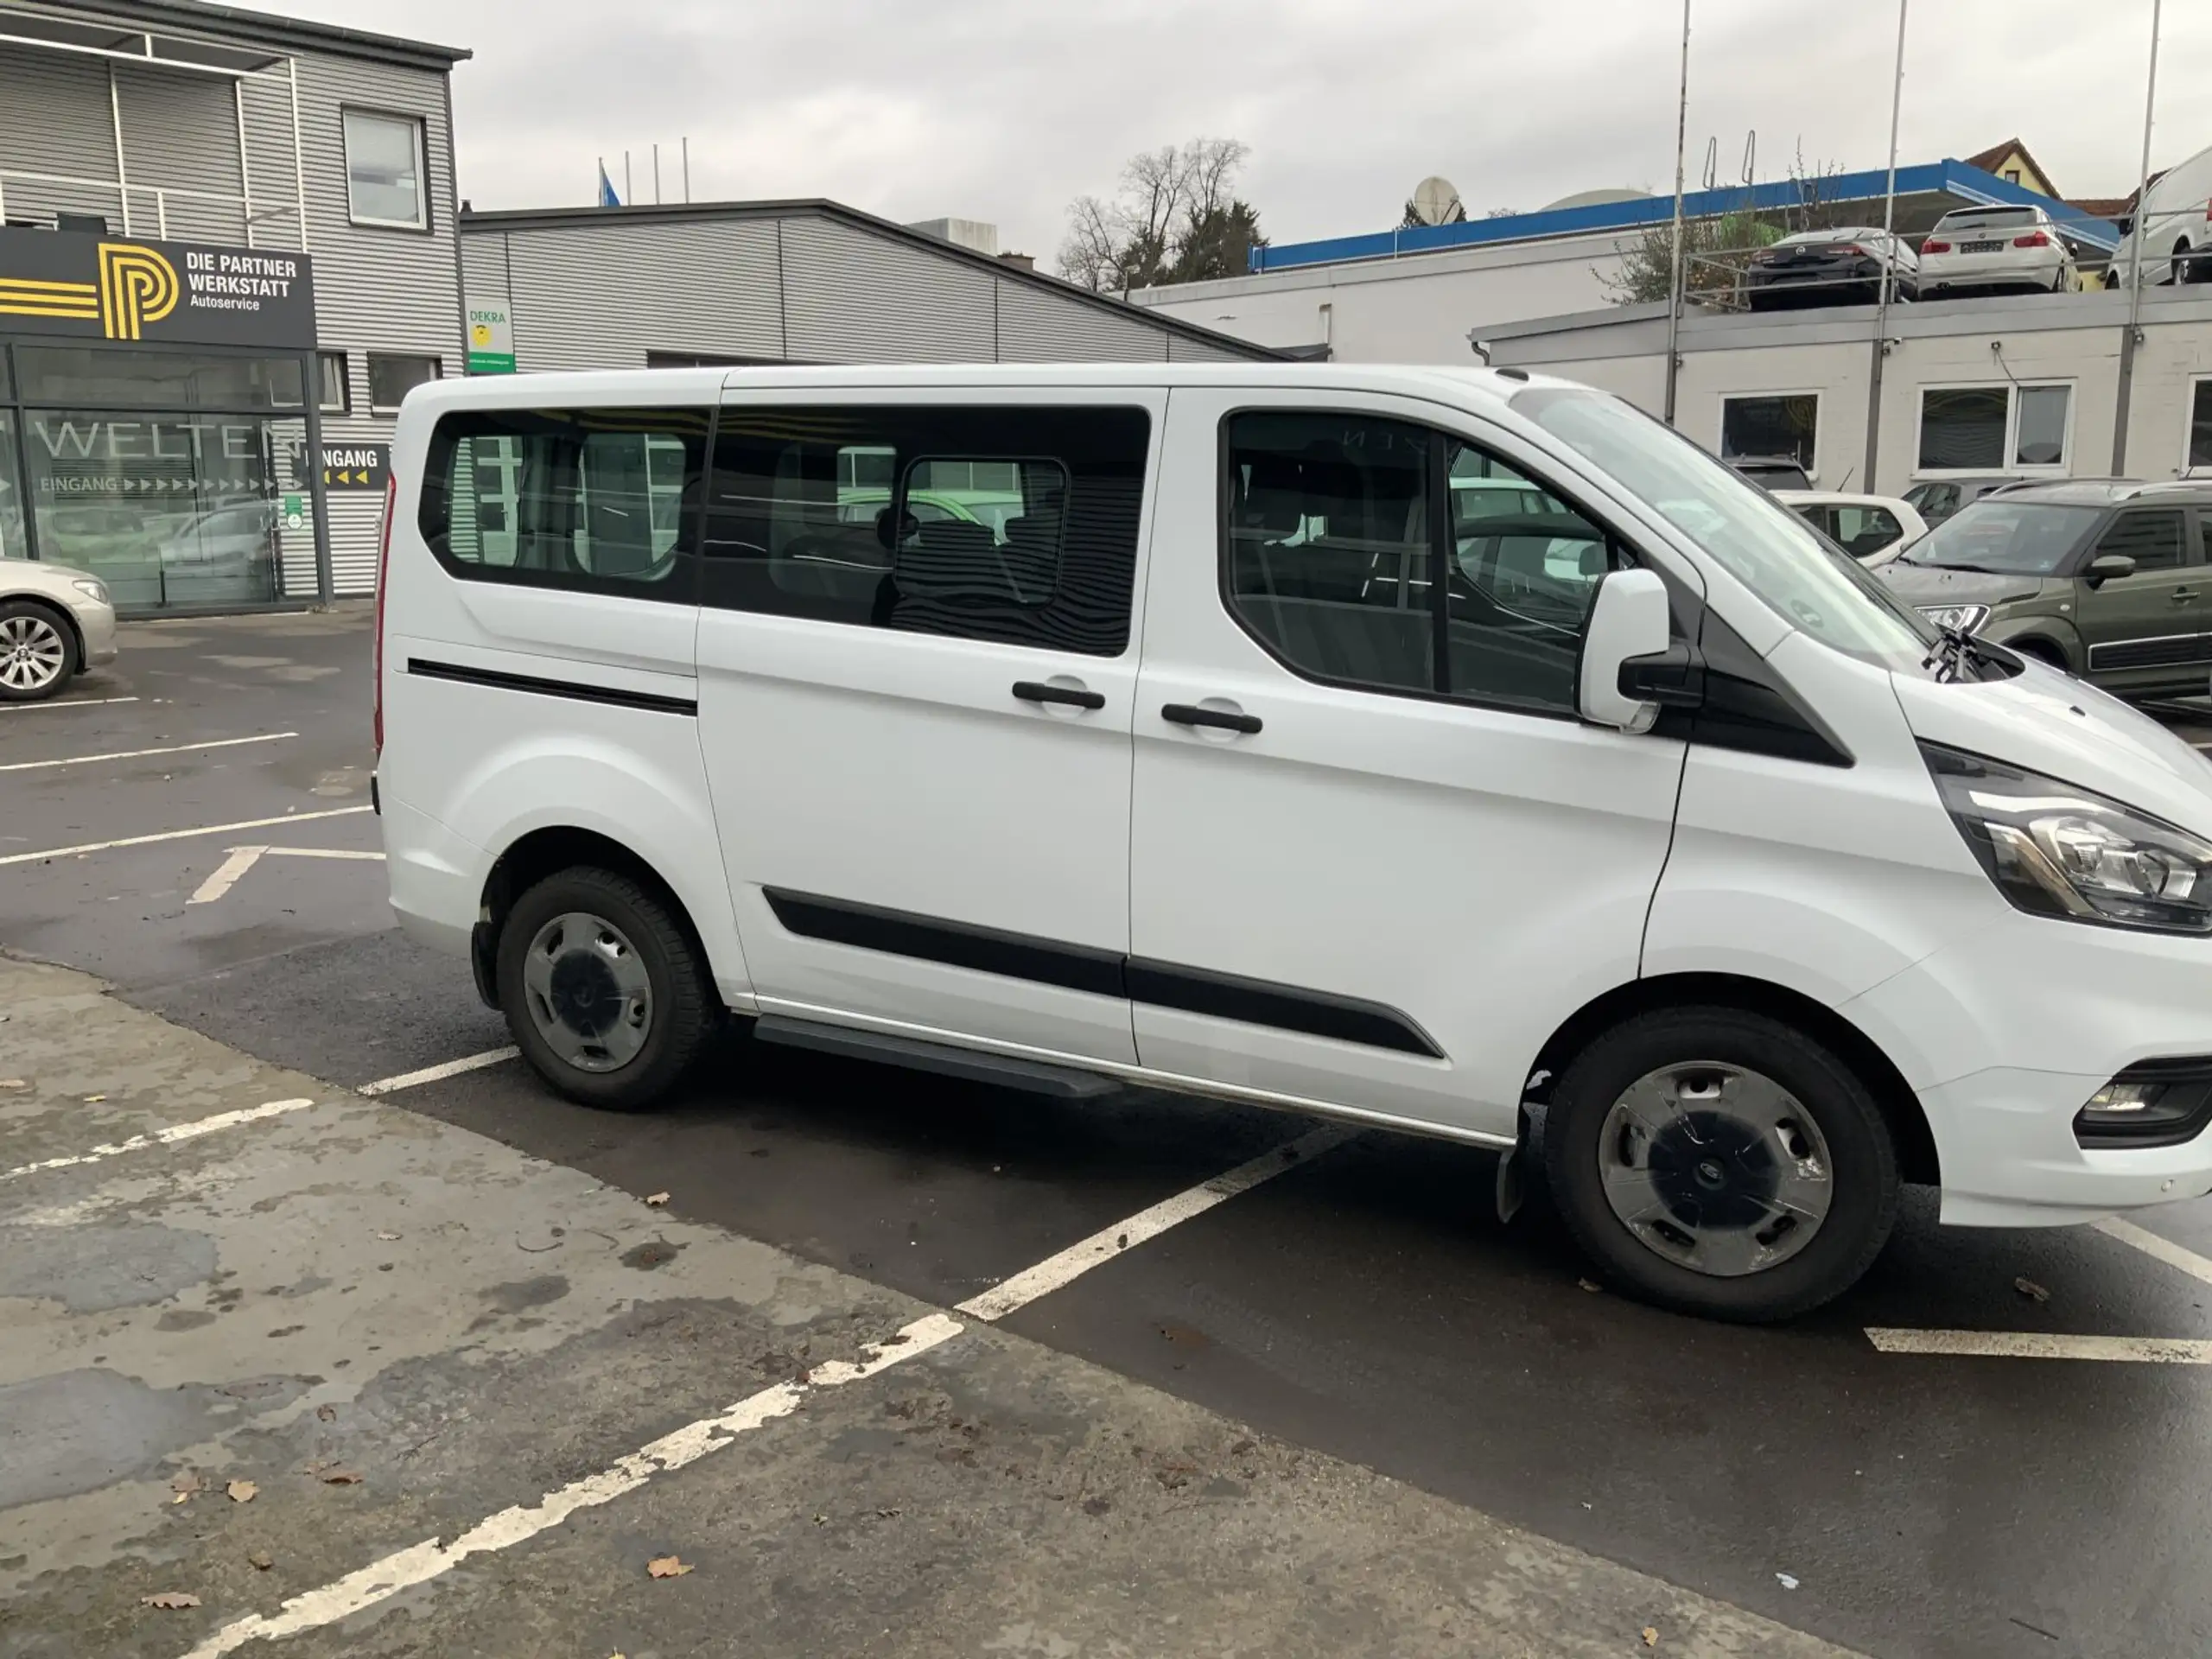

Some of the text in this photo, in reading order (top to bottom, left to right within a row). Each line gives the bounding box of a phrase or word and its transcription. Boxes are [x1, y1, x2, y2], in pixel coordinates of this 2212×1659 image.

[187, 251, 296, 277] DIE PARTNER
[188, 274, 290, 297] WERKSTATT
[190, 295, 260, 311] Autoservice
[469, 311, 506, 323] DEKRA
[35, 421, 302, 459] WELTEN
[305, 449, 378, 467] NGANG
[41, 476, 118, 492] EINGANG
